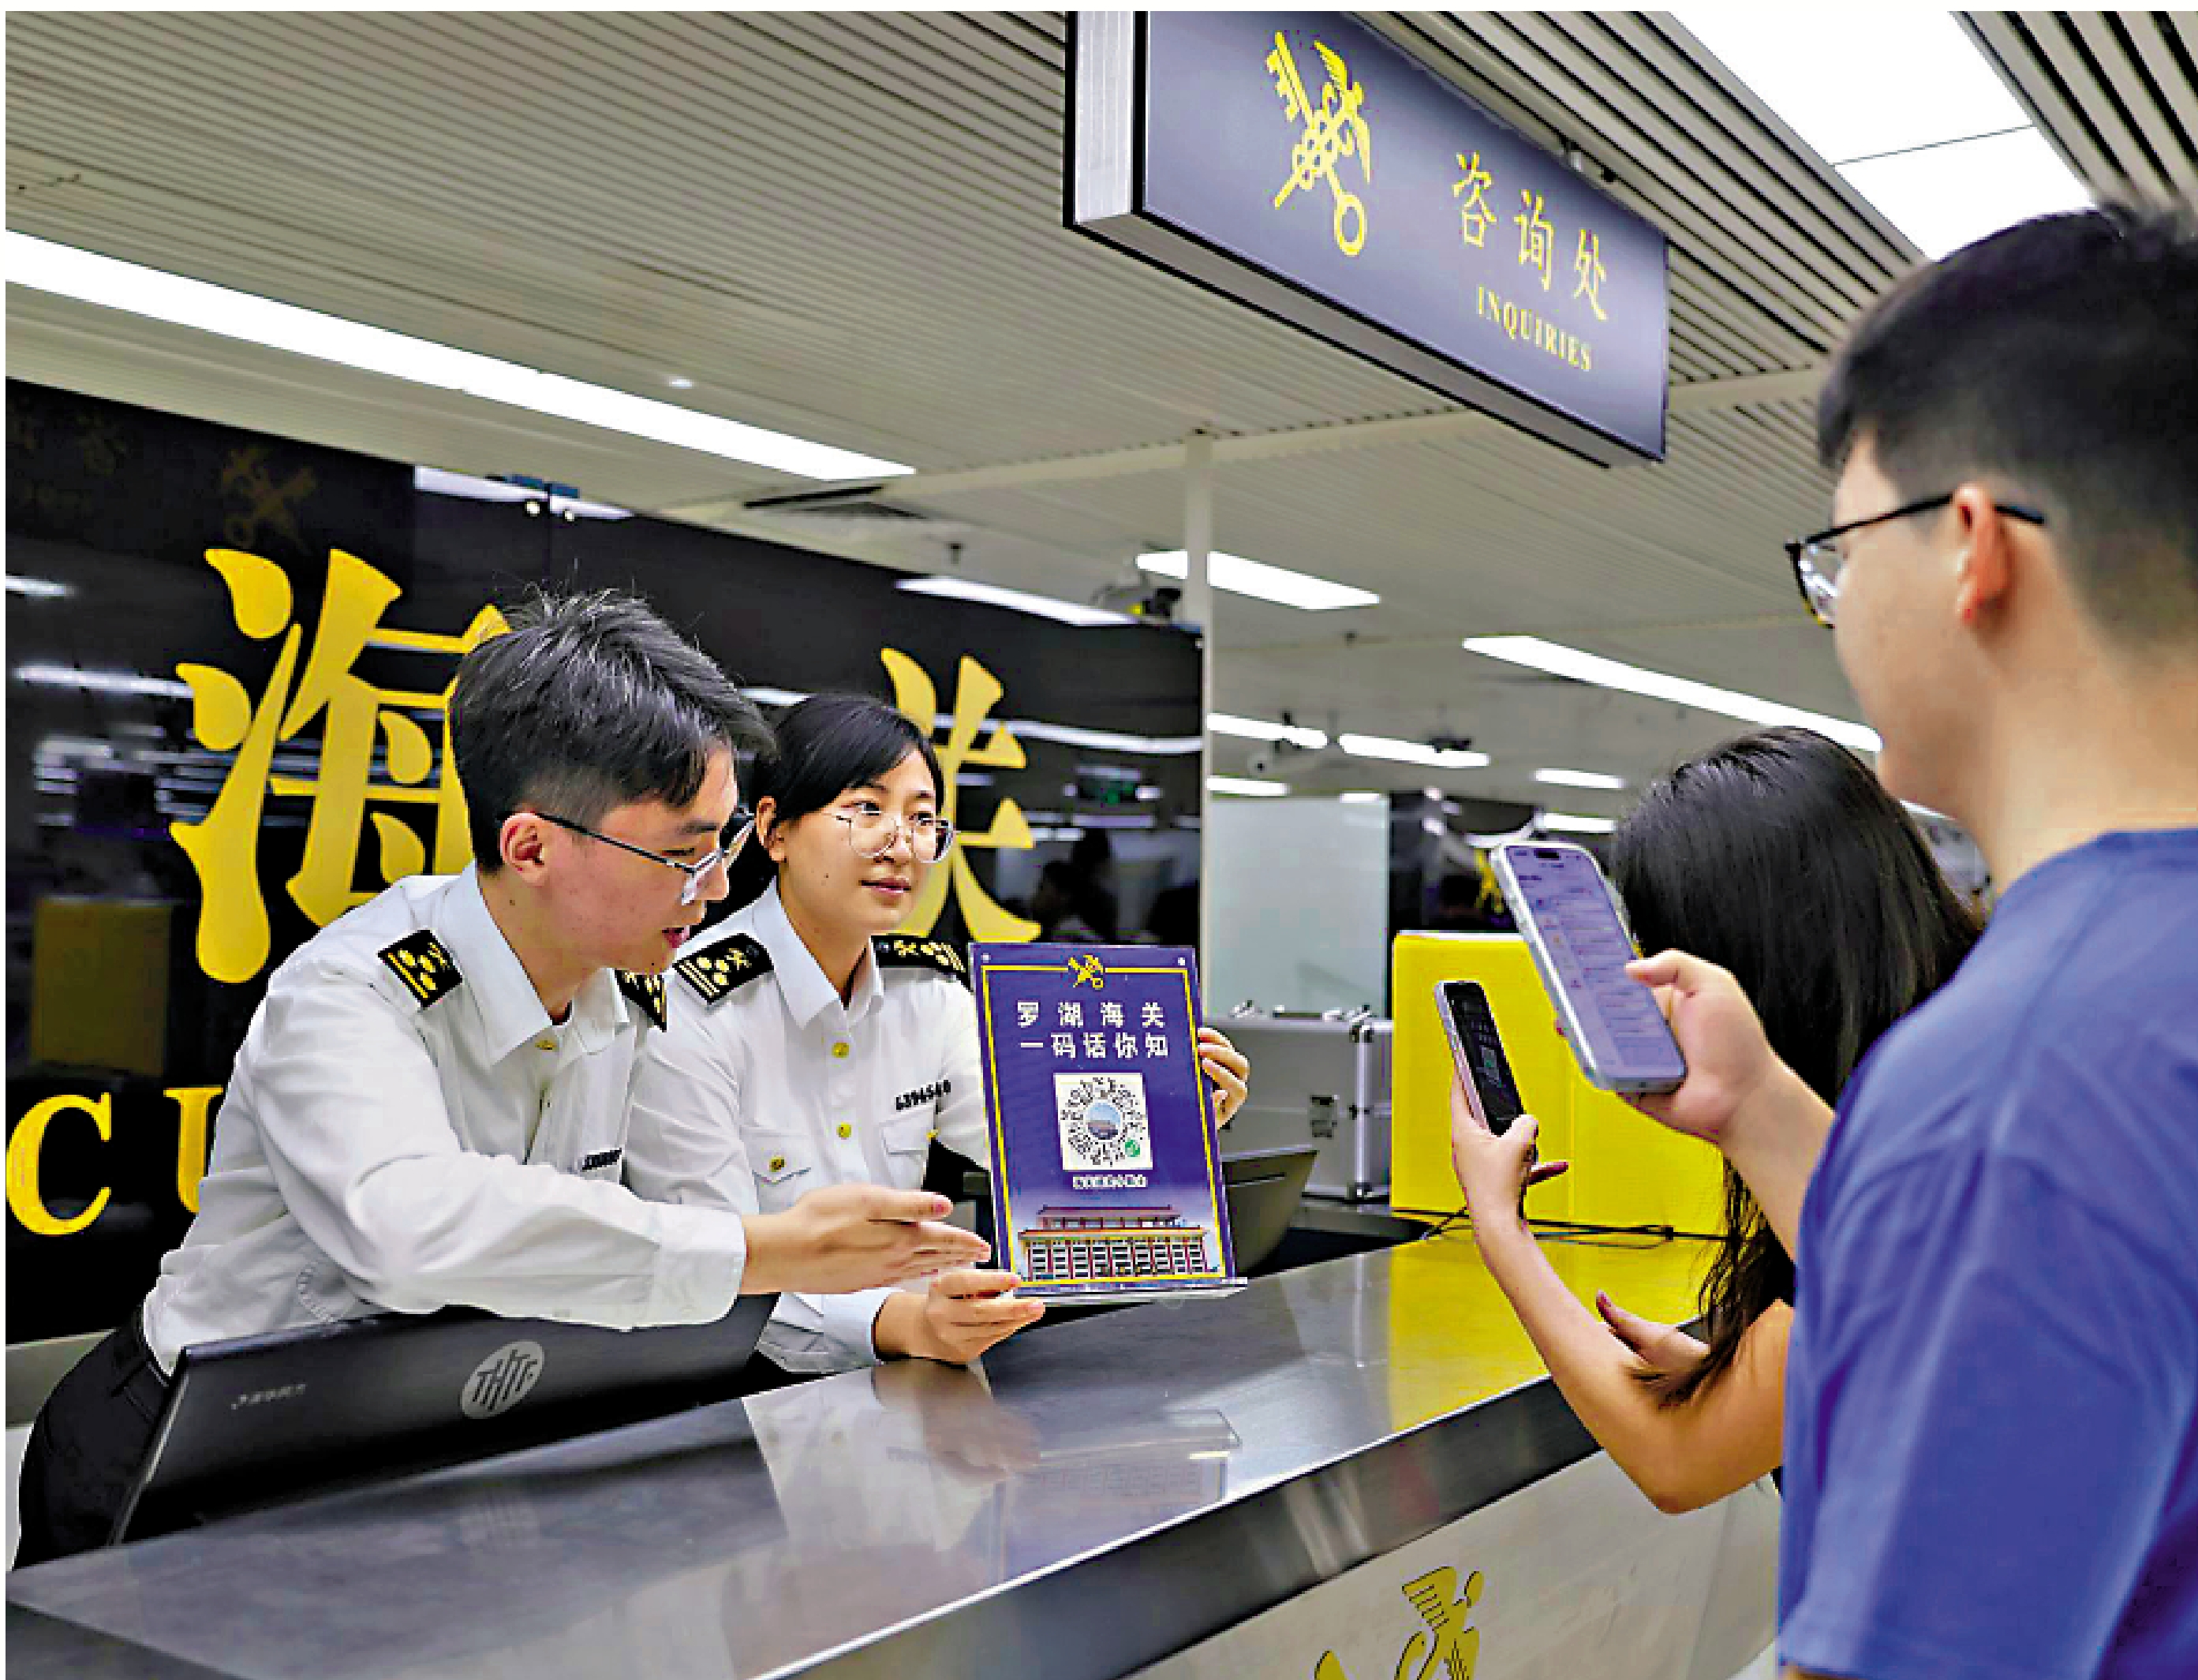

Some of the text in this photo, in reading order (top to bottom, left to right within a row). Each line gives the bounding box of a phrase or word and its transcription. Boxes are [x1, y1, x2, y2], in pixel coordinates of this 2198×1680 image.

[1452, 151, 1607, 321] 咨询处
[1476, 285, 1591, 371] INQUIRIES
[1016, 1002, 1166, 1029] 罗湖海关
[1019, 1032, 1168, 1060] 一码话你知
